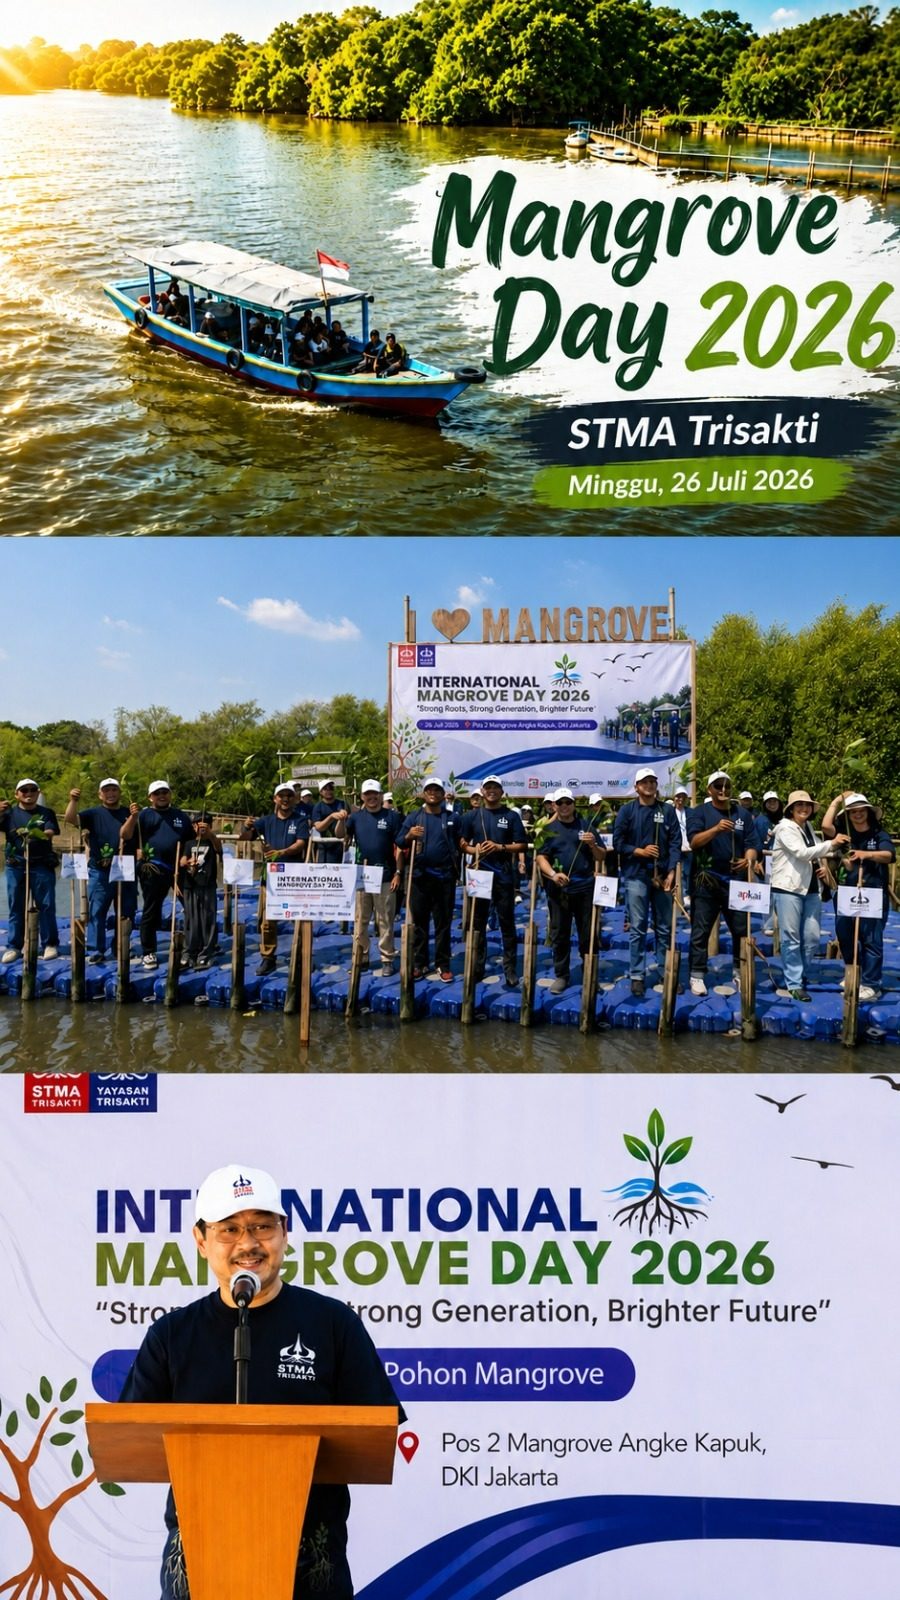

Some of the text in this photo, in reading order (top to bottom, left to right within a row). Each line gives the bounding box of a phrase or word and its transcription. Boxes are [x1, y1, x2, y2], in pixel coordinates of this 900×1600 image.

[482, 606, 669, 642] MANGROVE
[418, 676, 540, 688] INTERNATIONAL
[418, 689, 590, 702] MANGROVE DAY 2026
[445, 705, 468, 713] Roots,
[469, 705, 494, 713] Strong
[495, 705, 538, 713] Generation,
[539, 705, 568, 713] Brighter
[738, 889, 761, 900] apkai
[32, 1084, 81, 1097] STMA
[97, 1086, 149, 1096] YAYASAN
[31, 1099, 82, 1108] TRISAKTI
[96, 1097, 150, 1107] TRISAKTI
[96, 1188, 597, 1234] INTNATIONAL
[95, 1240, 775, 1286] MAROVE DAY 2026
[432, 1299, 598, 1327] Generation,
[608, 1298, 720, 1328] Brighter
[278, 1364, 315, 1375] STMA
[475, 1361, 604, 1391] Mangrove
[442, 1432, 767, 1459] Pos 2 Mangrove Angke Kapuk,
[442, 1466, 559, 1487] DKI Jakarta
